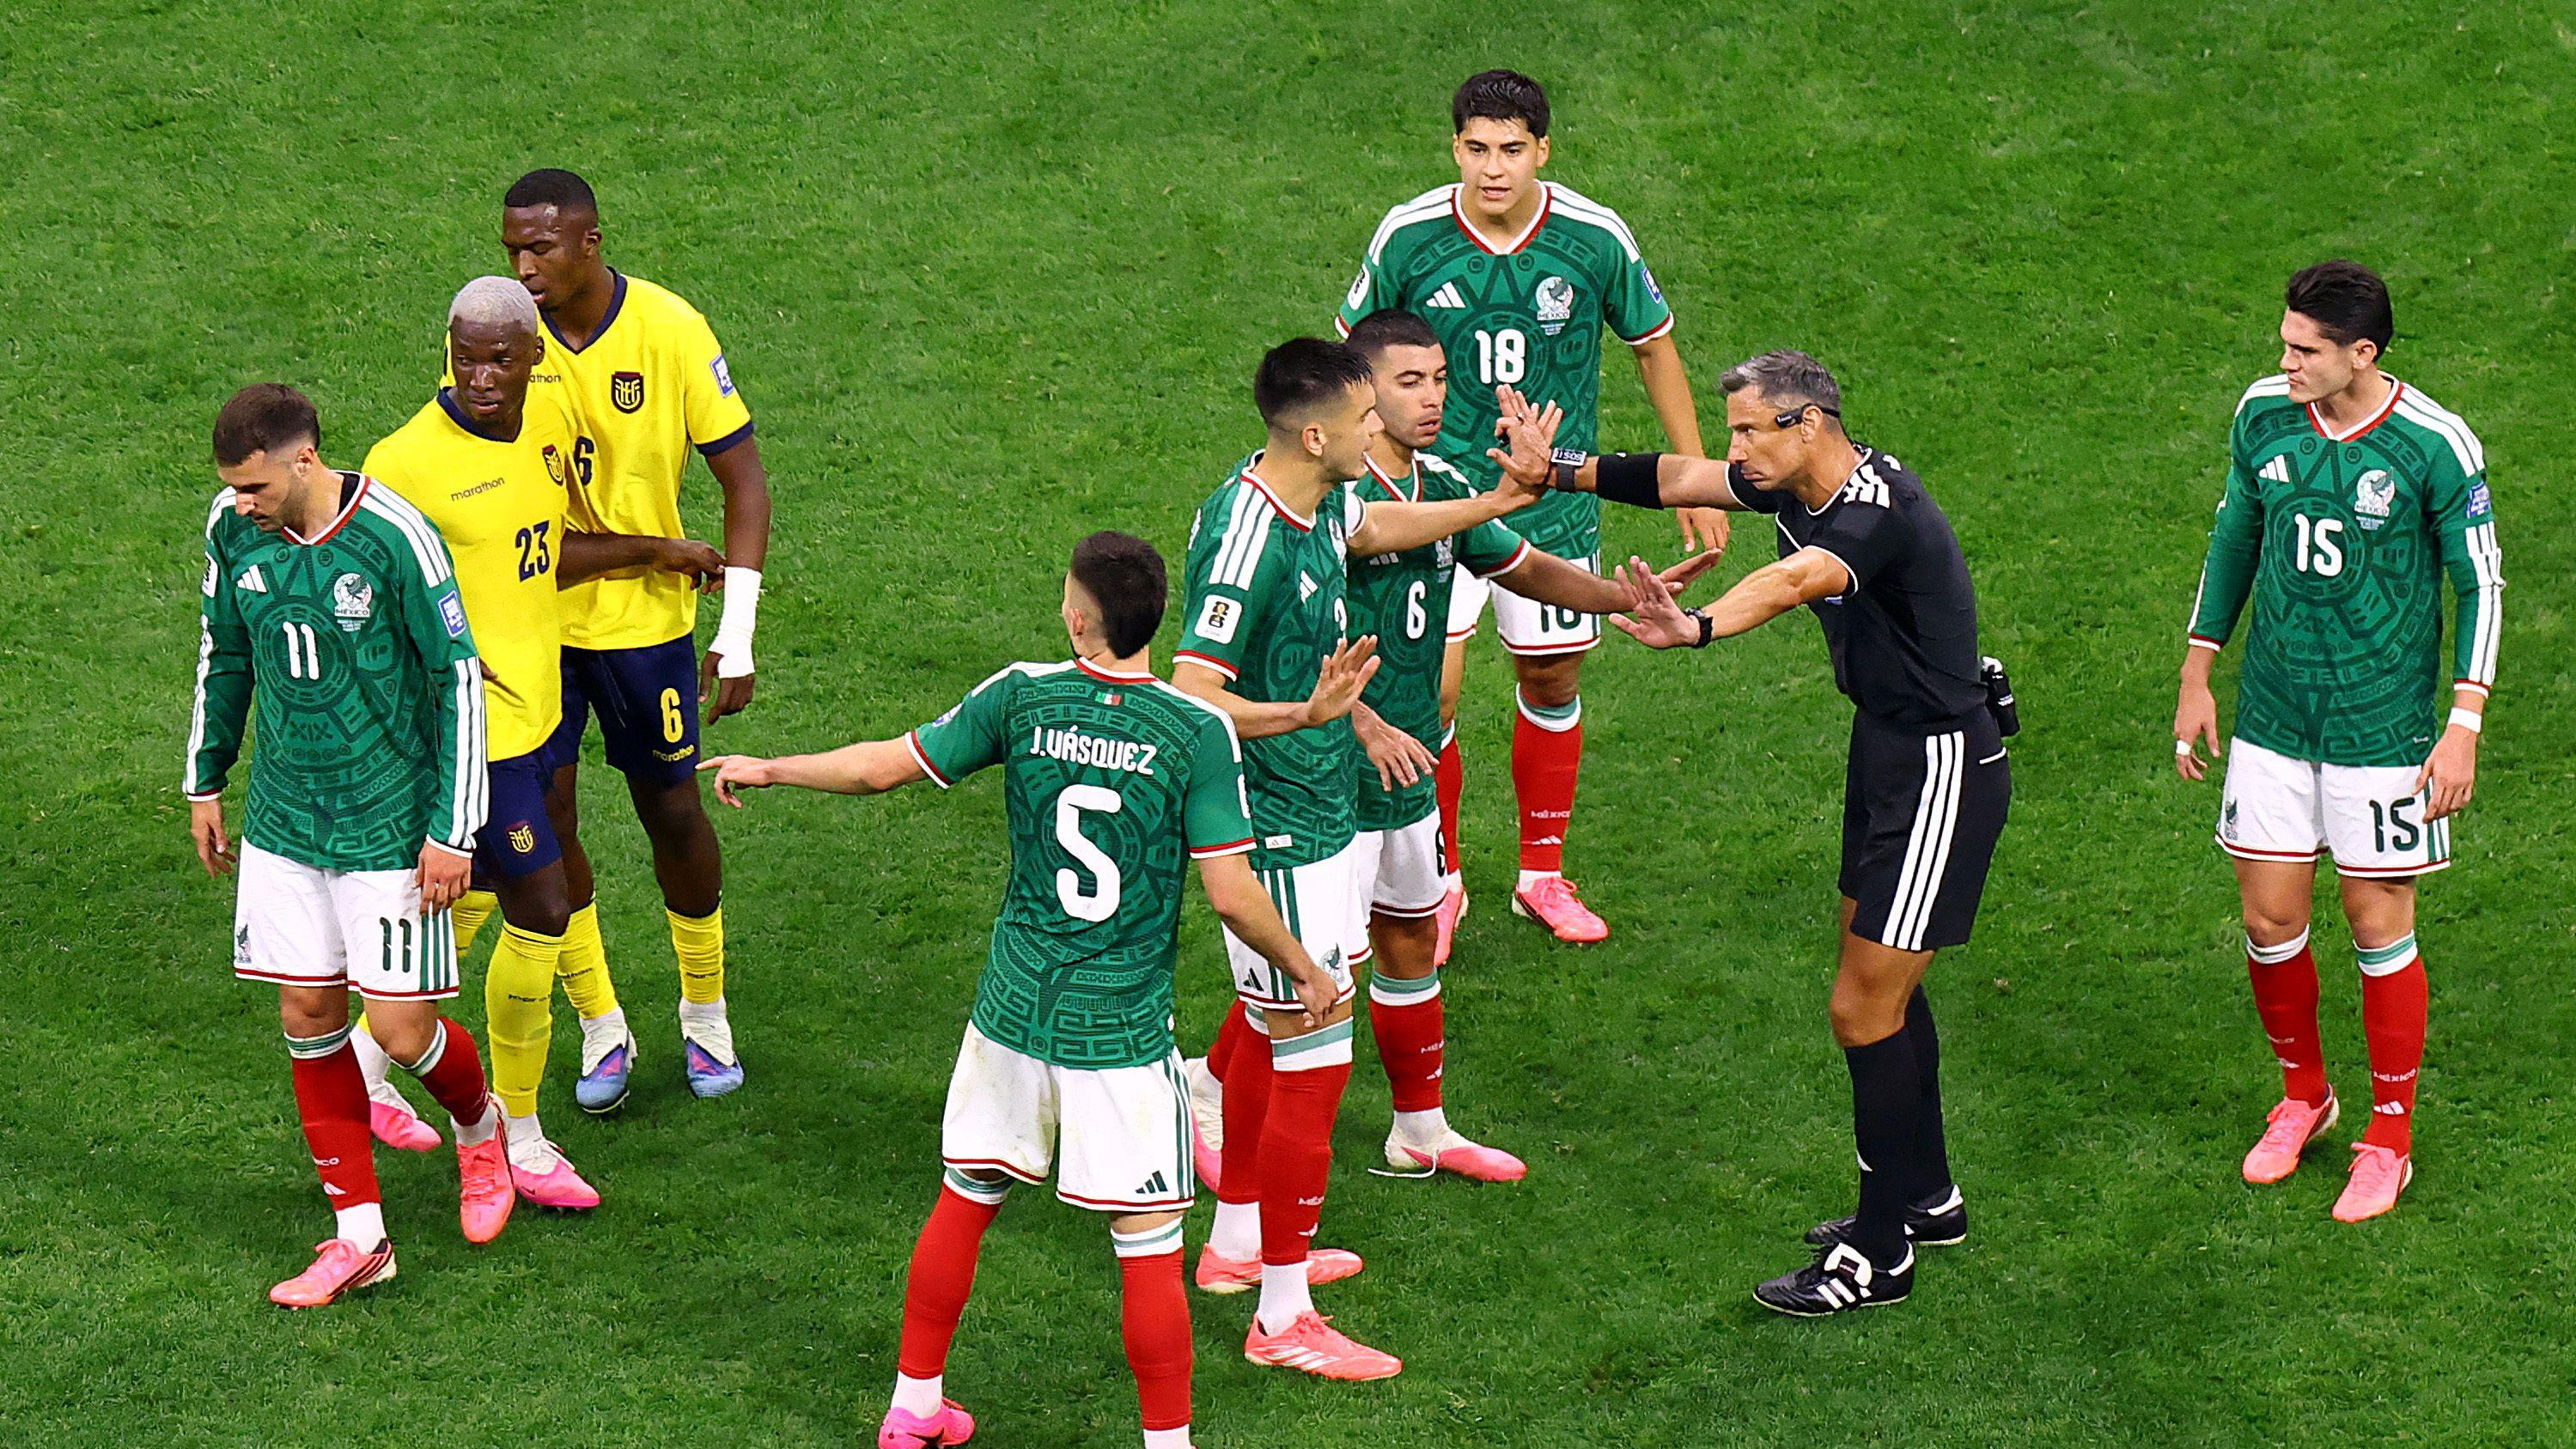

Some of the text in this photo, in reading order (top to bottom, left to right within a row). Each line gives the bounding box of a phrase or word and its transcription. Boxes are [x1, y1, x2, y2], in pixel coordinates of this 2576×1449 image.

[529, 373, 562, 383] athon
[1474, 328, 1526, 384] 18
[574, 435, 594, 486] 6
[451, 477, 505, 502] marathon
[515, 520, 551, 582] 23
[2294, 513, 2343, 576] 15
[1406, 580, 1427, 640] 6
[283, 621, 320, 680] 11
[660, 687, 684, 743] 6
[1030, 724, 1157, 775] J.VÁSQUEZ
[1056, 783, 1122, 922] 5
[2369, 796, 2420, 853] 15
[380, 916, 411, 973] 11
